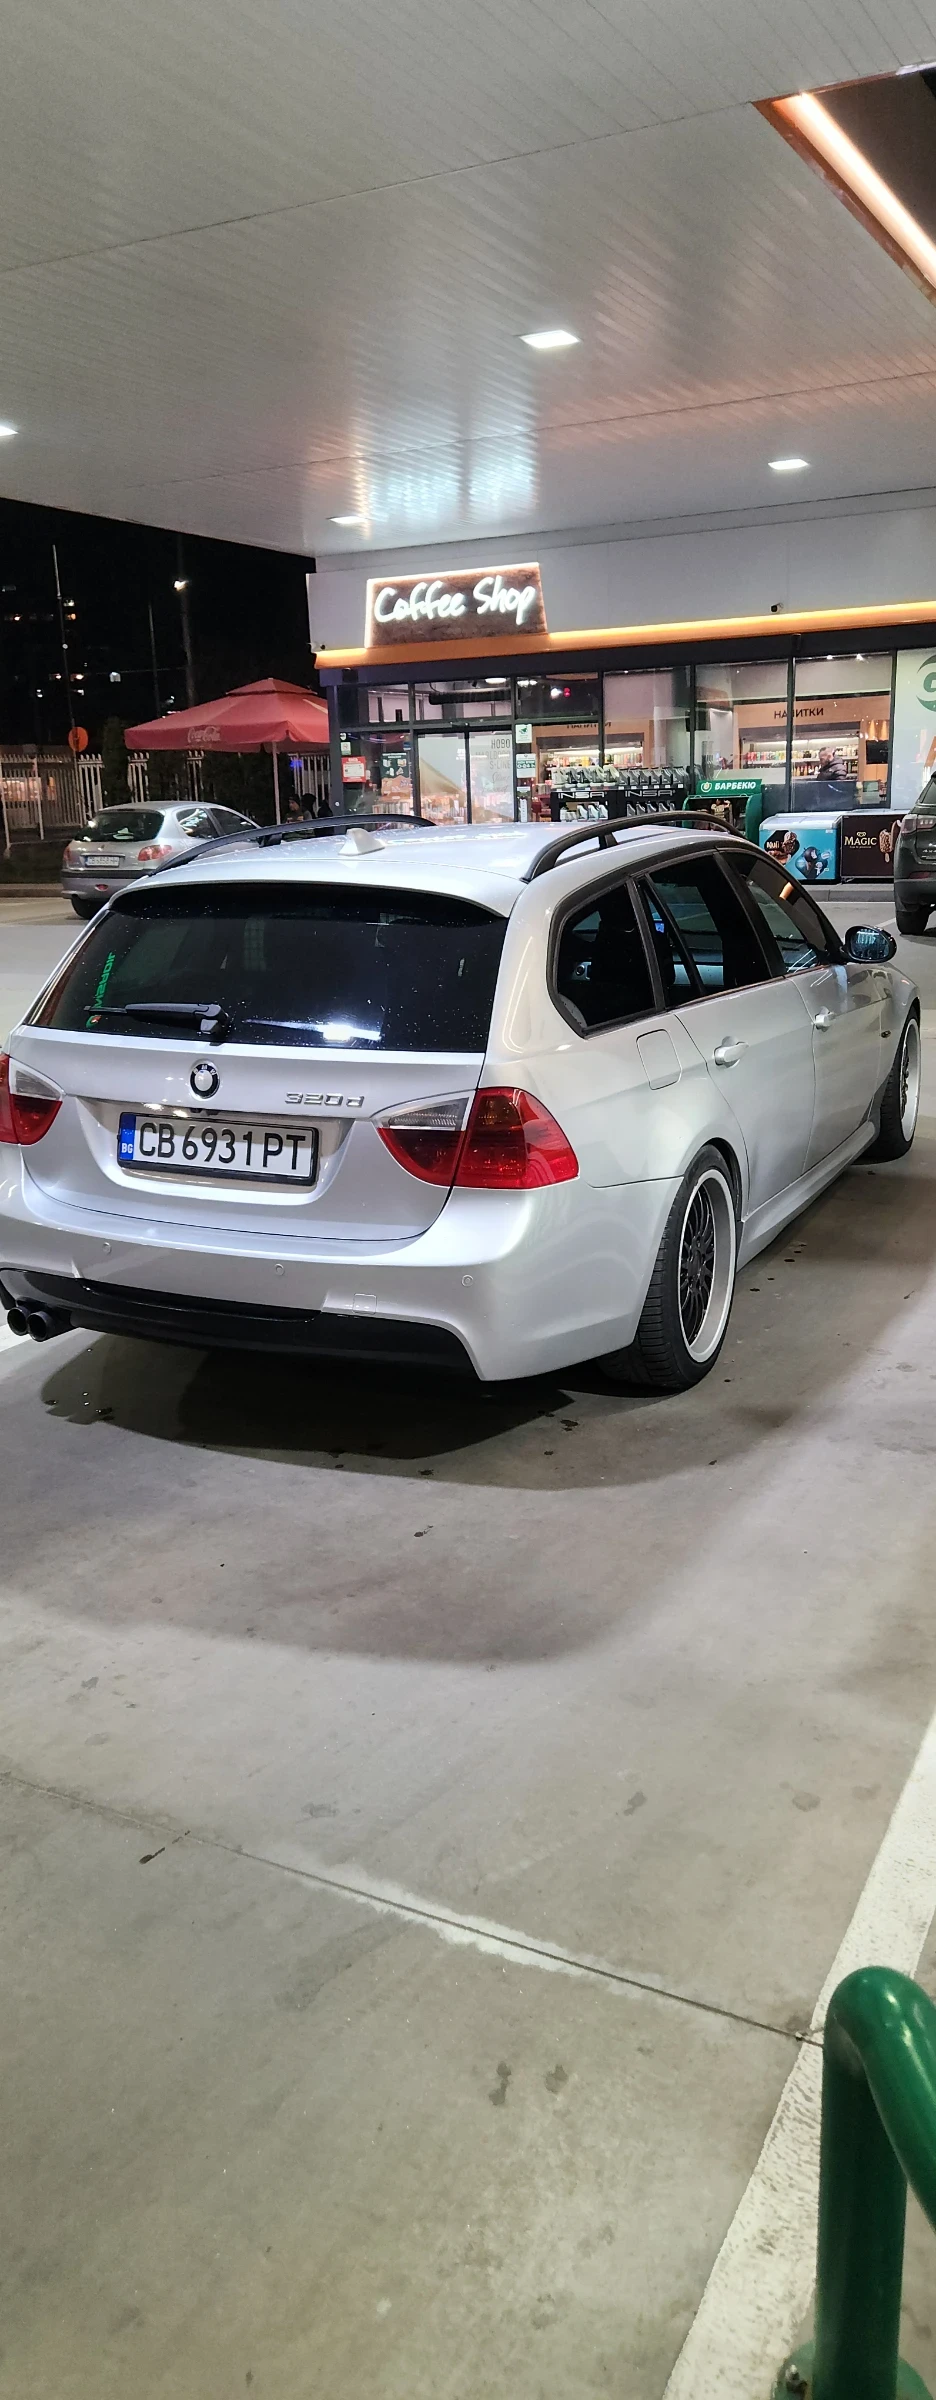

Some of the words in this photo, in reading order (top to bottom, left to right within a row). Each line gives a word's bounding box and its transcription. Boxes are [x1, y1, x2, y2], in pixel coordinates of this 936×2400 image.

[373, 580, 468, 623] Coffee
[472, 575, 536, 626] Shop
[714, 781, 757, 790] БАРБЕКЮ
[557, 791, 605, 799] INSA
[625, 790, 673, 798] INSA
[844, 835, 877, 846] MAGIC
[192, 1064, 218, 1076] BMW
[285, 1091, 365, 1108] 320d
[121, 1143, 134, 1154] BG
[139, 1122, 175, 1158] CB
[182, 1125, 252, 1166] 6931
[262, 1132, 306, 1170] PT
